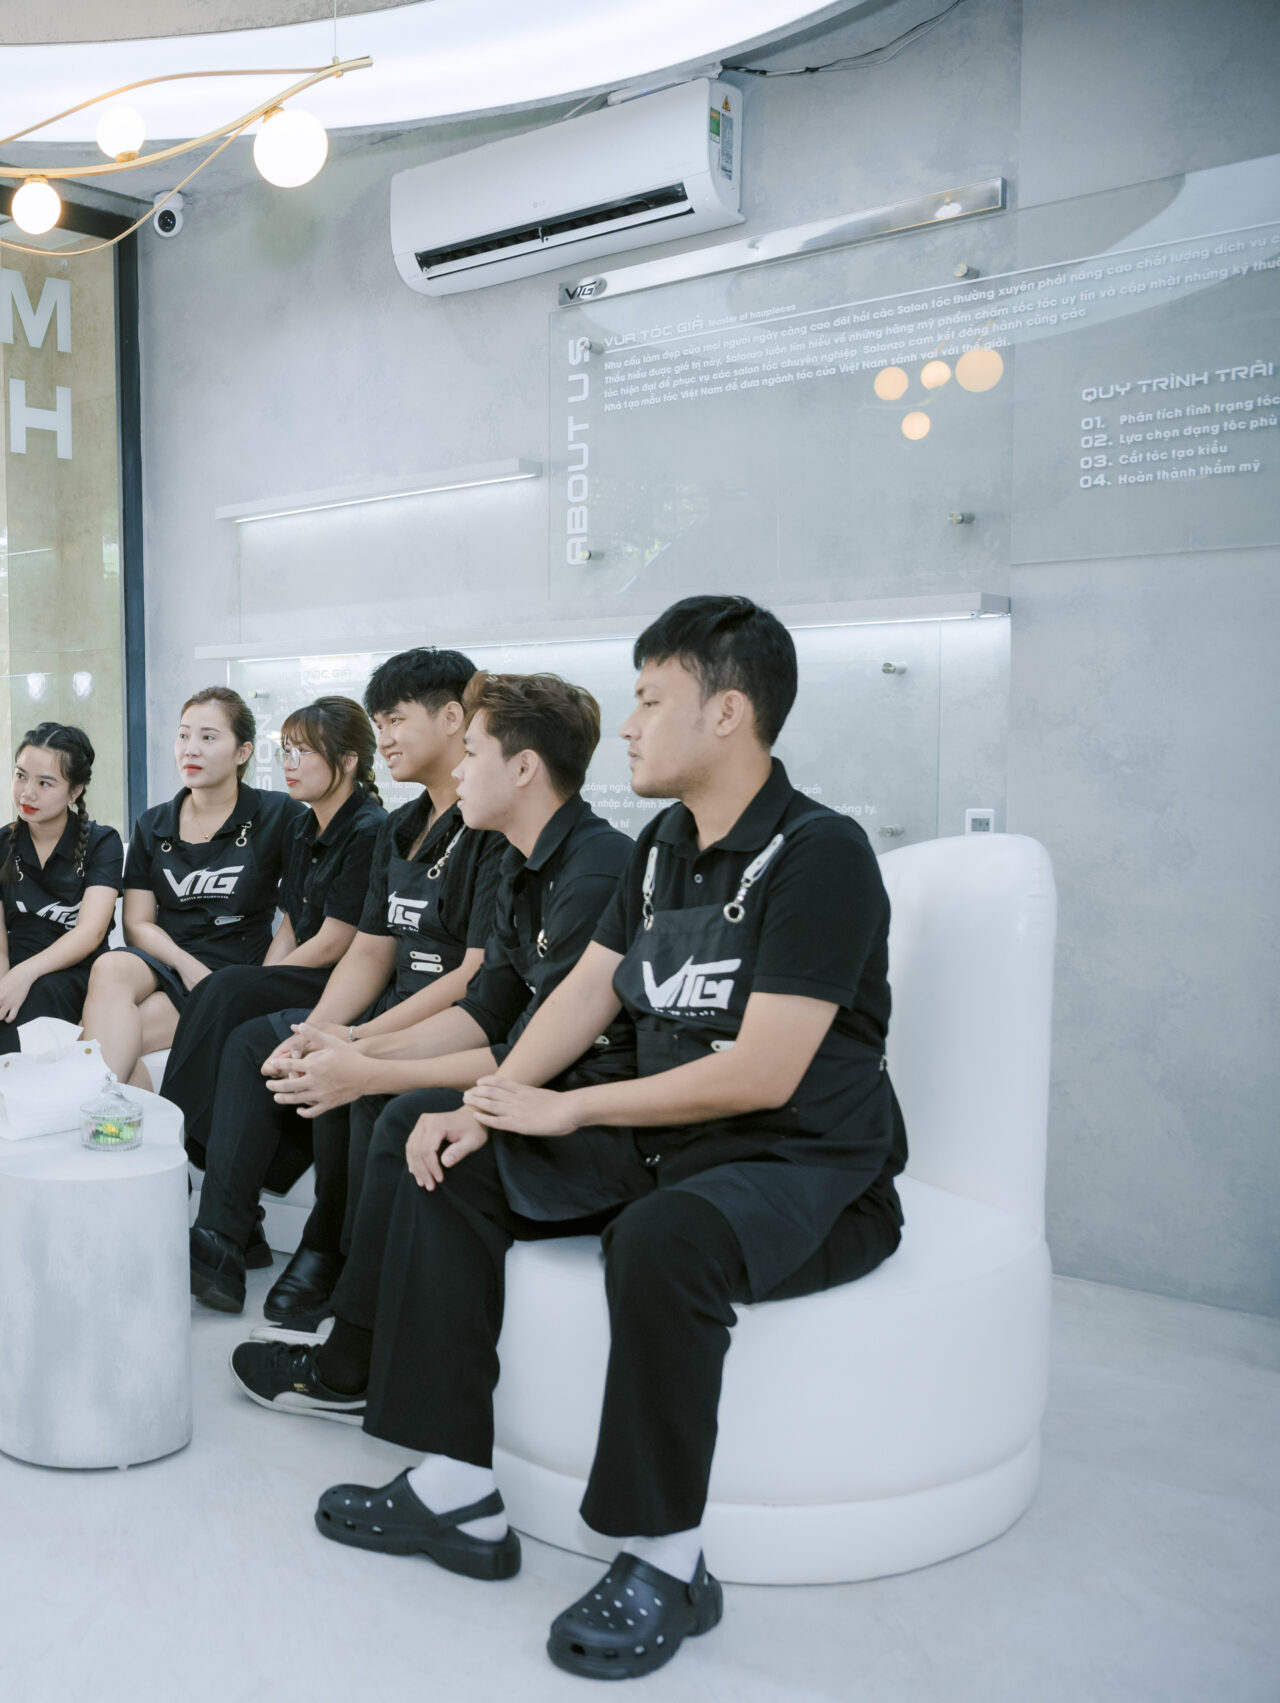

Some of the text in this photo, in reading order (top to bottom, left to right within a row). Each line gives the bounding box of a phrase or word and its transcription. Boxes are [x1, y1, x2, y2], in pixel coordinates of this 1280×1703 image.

[564, 281, 599, 300] VTG
[604, 332, 635, 347] VUA
[677, 314, 703, 333] GIẢ
[1081, 382, 1131, 402] QUY
[1137, 372, 1209, 393] TRÌNH
[1081, 393, 1280, 431] 01. Phân tích tình trạng tóc
[1080, 413, 1278, 449] 02. Lựa chọn dạng tóc phù
[566, 336, 590, 565] ABOUT US
[1080, 454, 1113, 469] 03.
[1146, 449, 1168, 462] tóc
[1171, 446, 1194, 461] tạo
[1198, 439, 1228, 455] kiểu
[1080, 458, 1261, 489] 04. Hoàn thành thẩm mỹ
[256, 713, 273, 791] SION
[163, 865, 244, 897] VTG
[642, 955, 742, 1009] VTG
